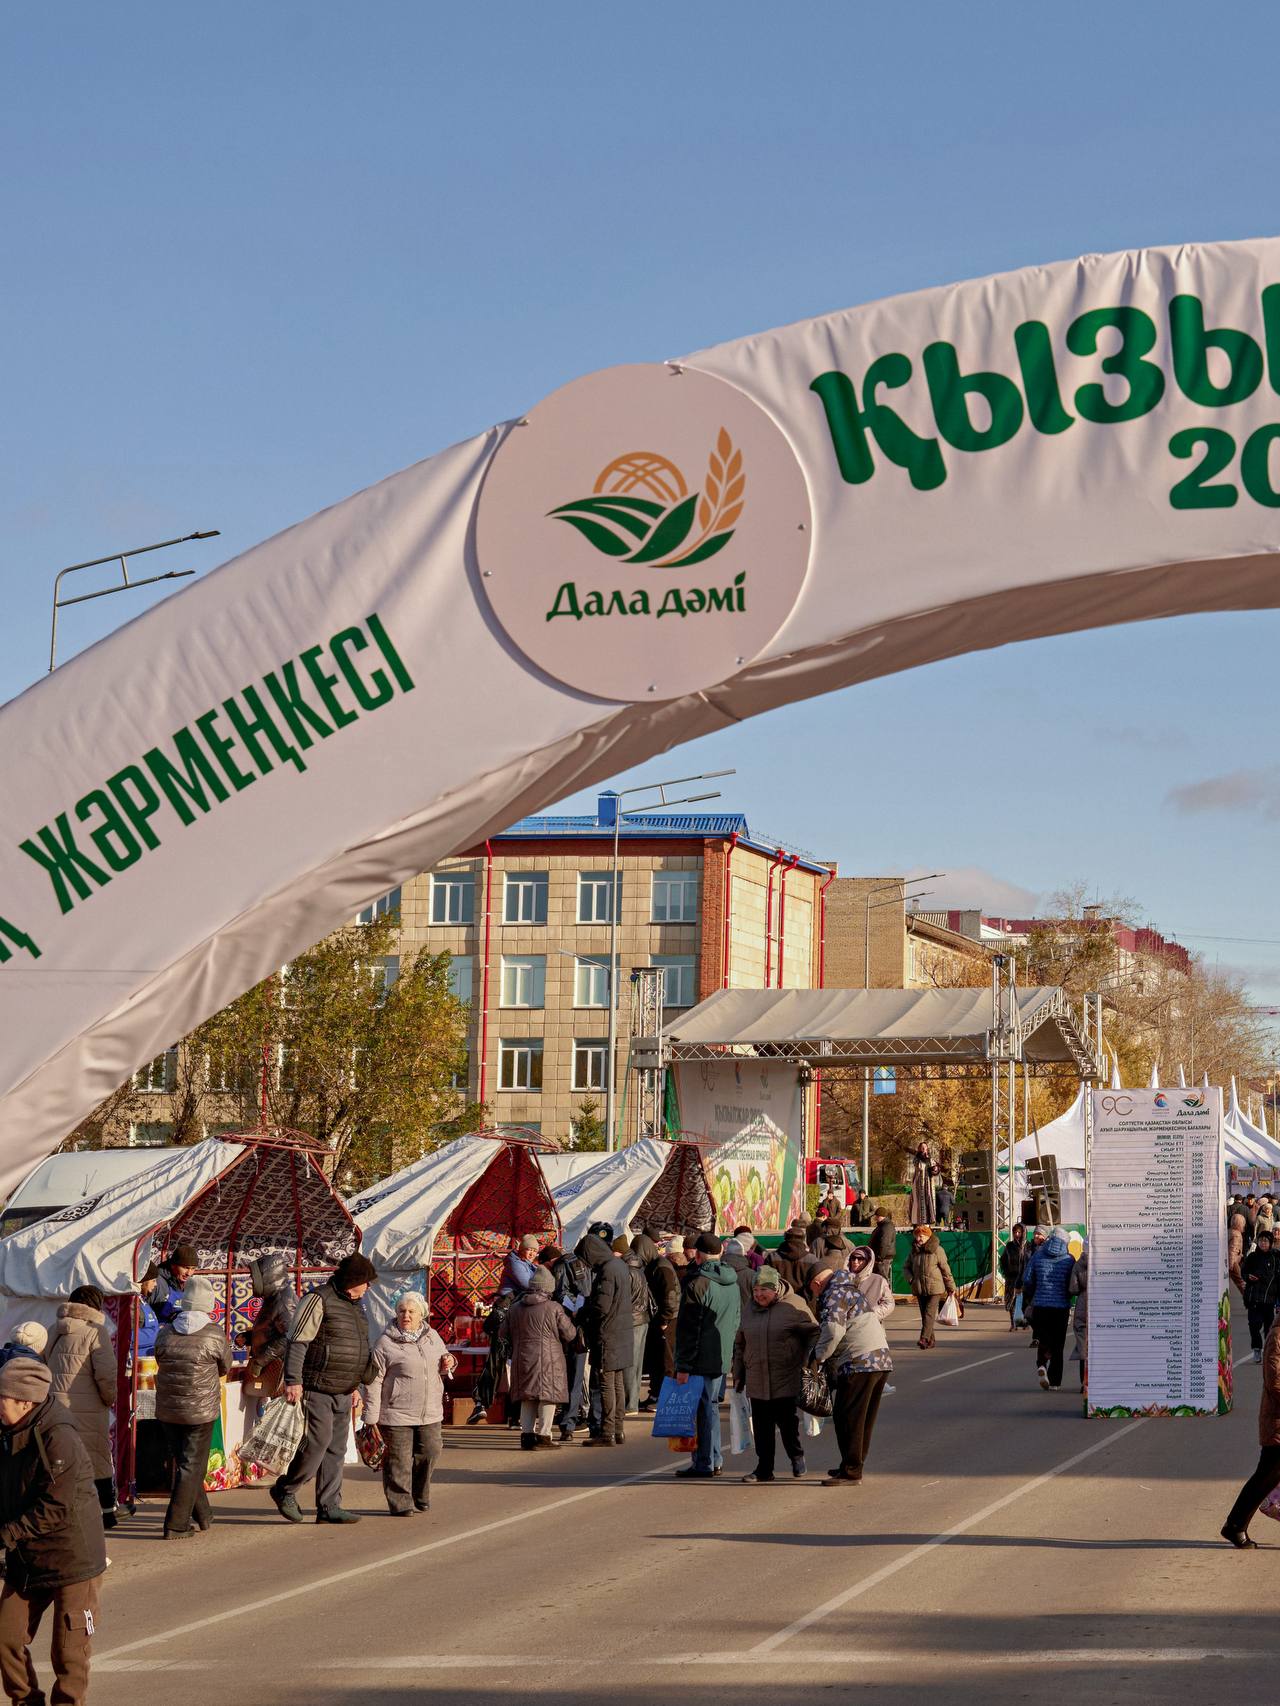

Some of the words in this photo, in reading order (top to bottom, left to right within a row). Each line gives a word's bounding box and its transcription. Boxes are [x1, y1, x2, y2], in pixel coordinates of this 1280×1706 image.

[545, 582, 650, 623] Дала
[656, 570, 746, 620] дәмі
[18, 613, 416, 915] ЖӘРМЕҢКЕСІ
